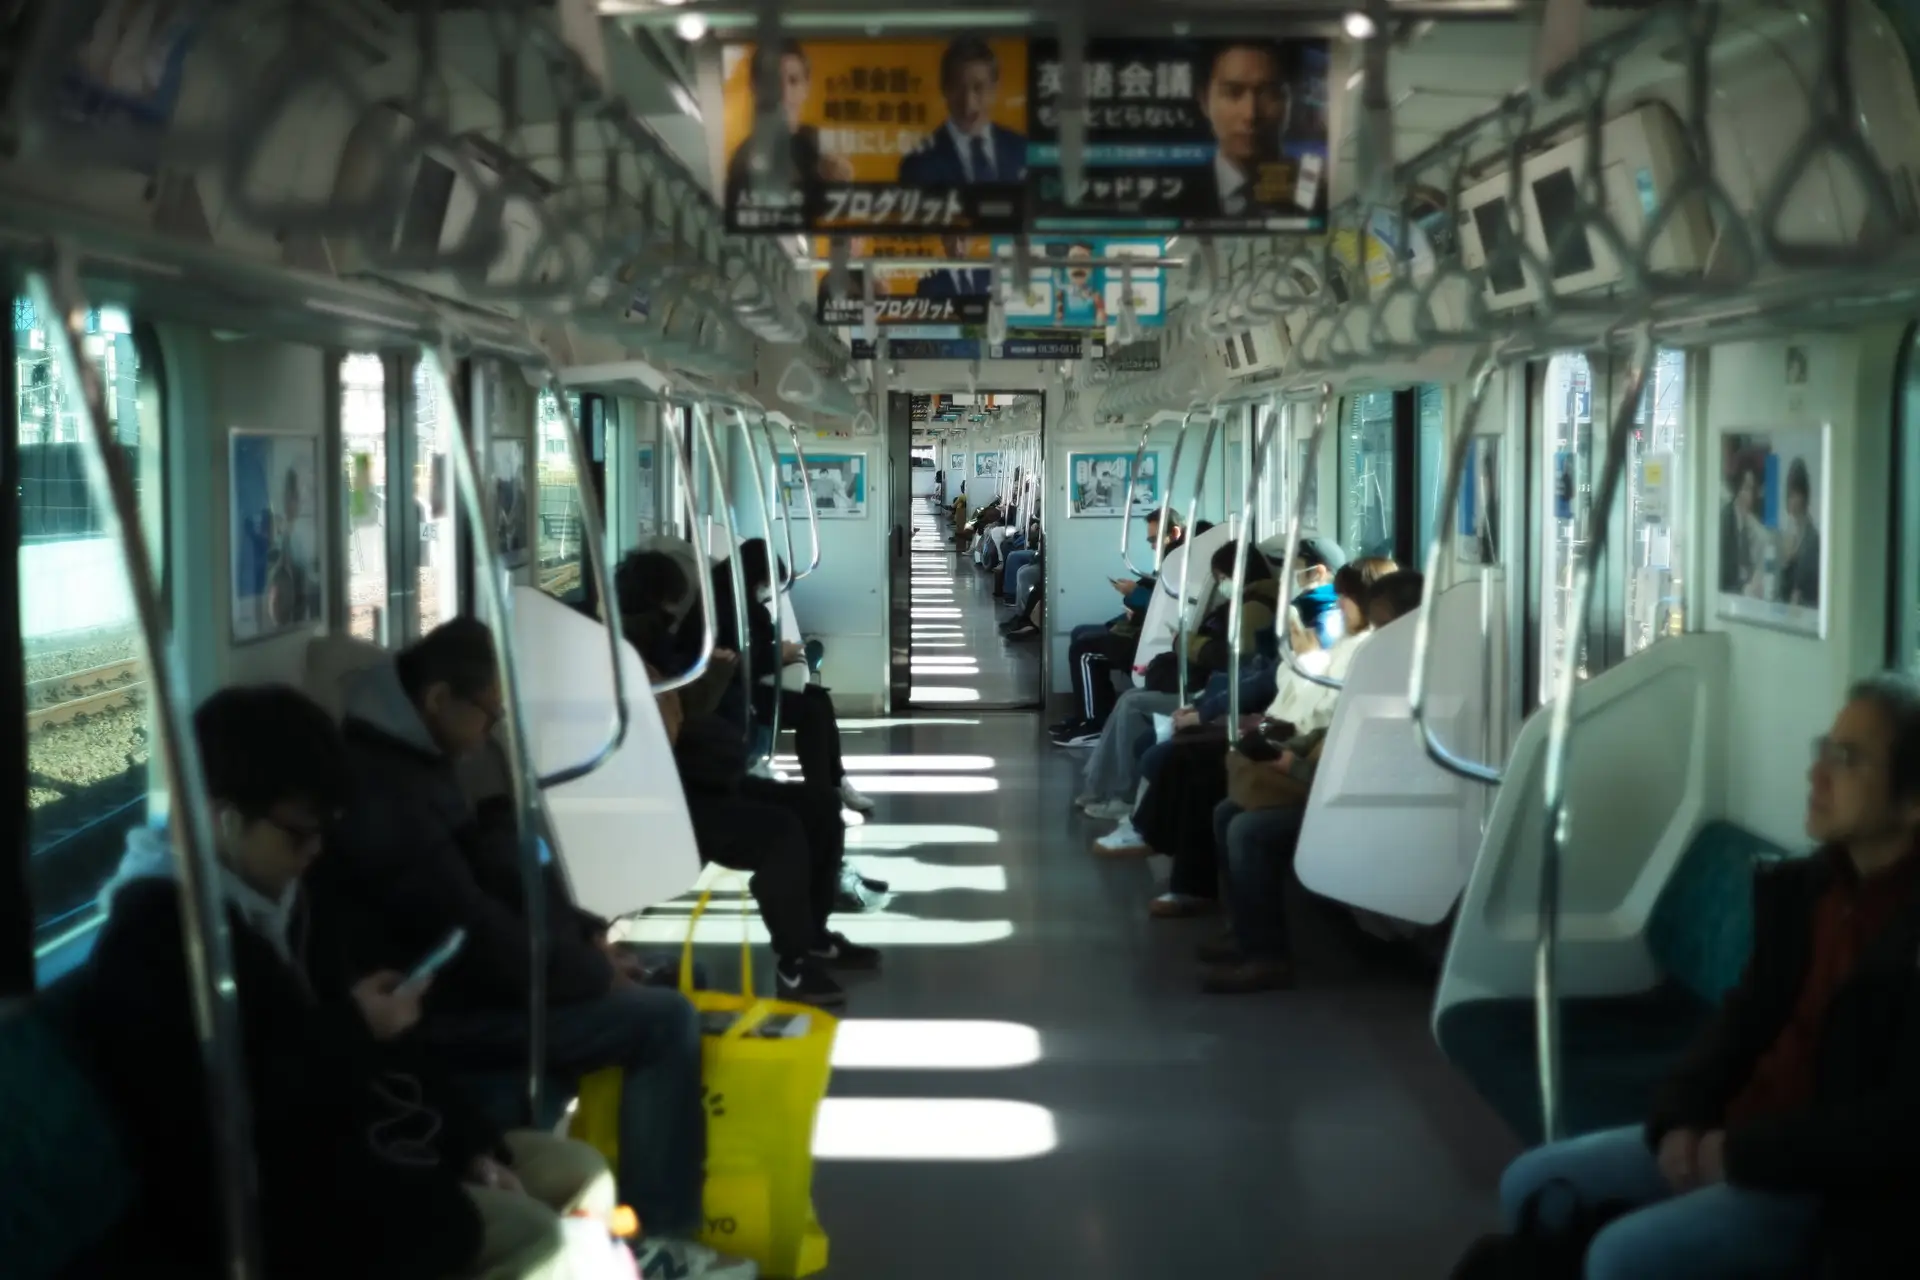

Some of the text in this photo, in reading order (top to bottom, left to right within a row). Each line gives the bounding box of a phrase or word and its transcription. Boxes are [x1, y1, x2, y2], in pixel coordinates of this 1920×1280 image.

[824, 189, 963, 223] プログリット
[874, 297, 955, 320] プログリット
[708, 1216, 737, 1235] YO
